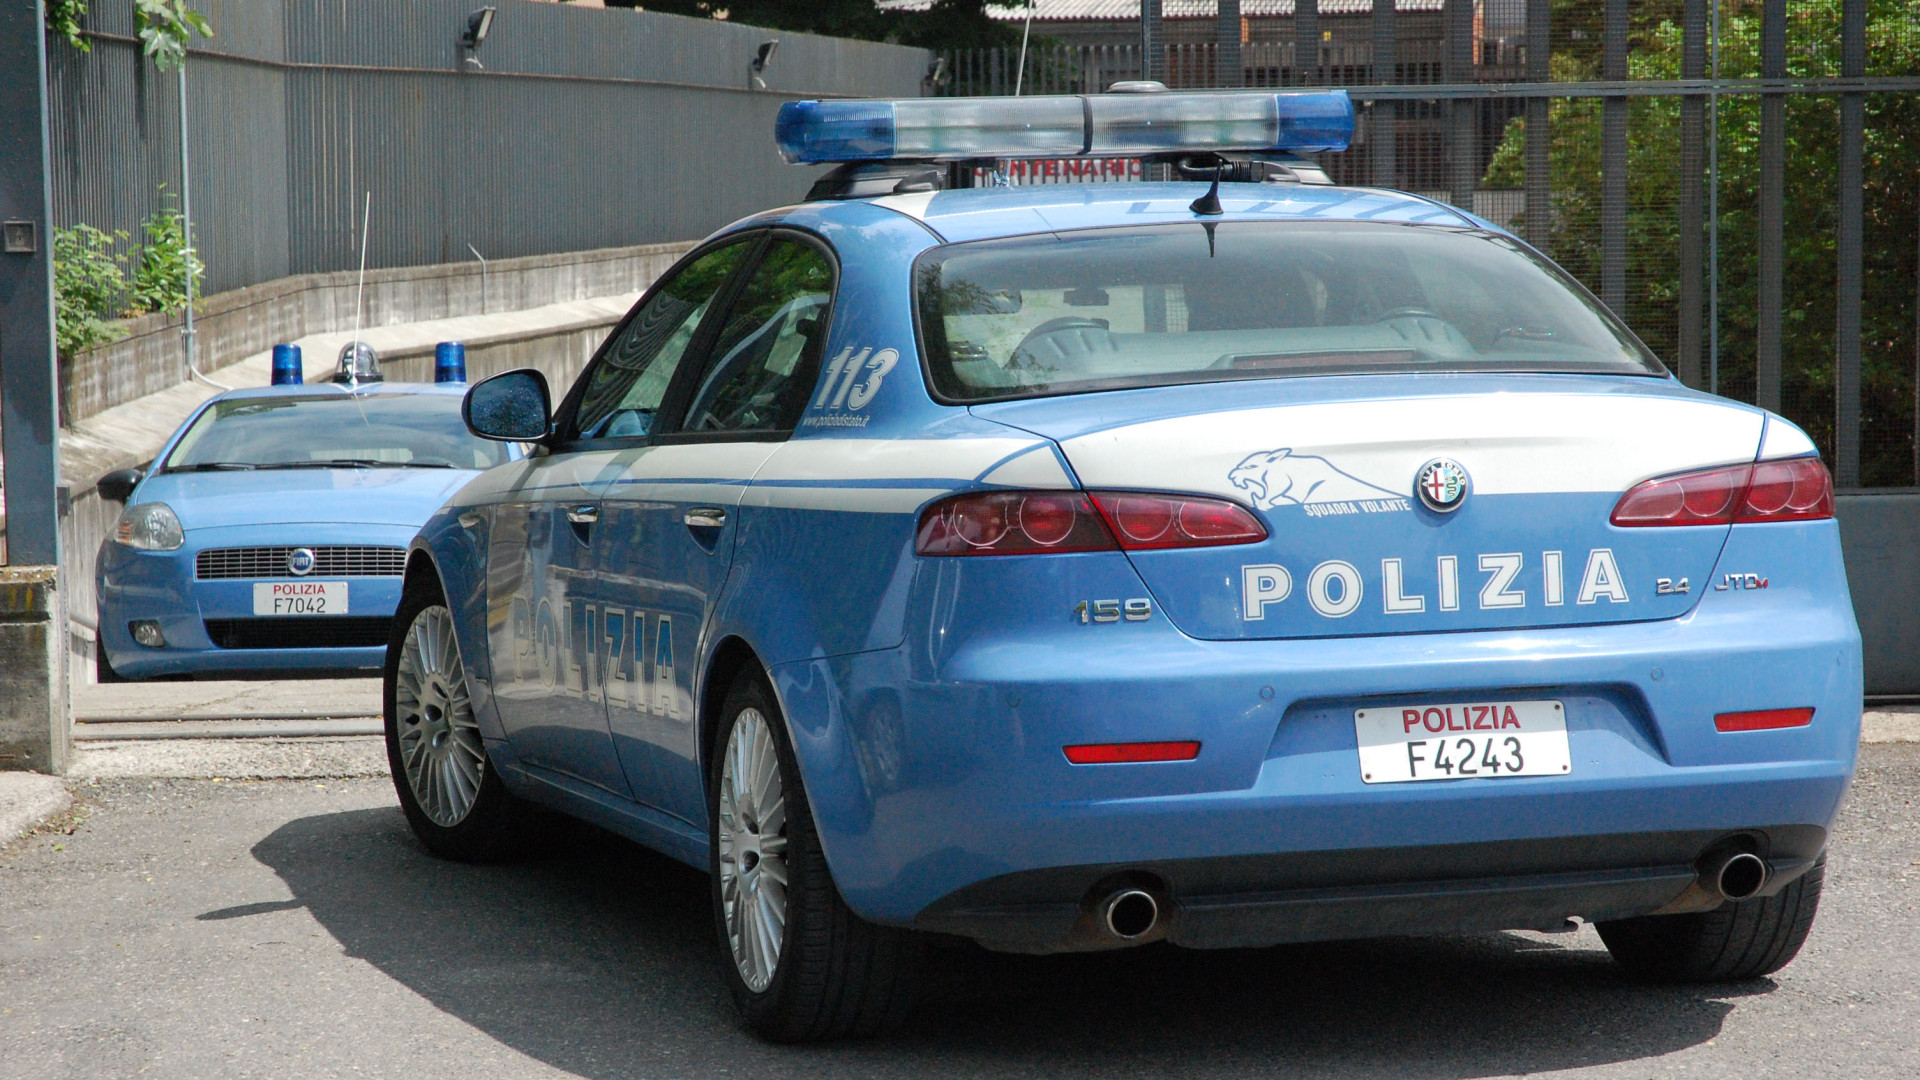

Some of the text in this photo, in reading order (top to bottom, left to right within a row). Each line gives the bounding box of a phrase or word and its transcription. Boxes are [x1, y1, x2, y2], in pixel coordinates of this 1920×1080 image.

[813, 346, 899, 410] 113
[802, 413, 870, 428] www.poliziadistato.it
[1303, 498, 1412, 518] SQUADRA VOLANTE
[292, 556, 310, 566] FIAT
[273, 584, 326, 595] POLIZIA
[1241, 547, 1630, 621] POLIZIA
[274, 597, 326, 614] F7042
[1075, 598, 1151, 623] 159
[512, 593, 681, 720] POLIZIA
[1402, 705, 1521, 733] POLIZIA
[1407, 736, 1524, 777] F4243
